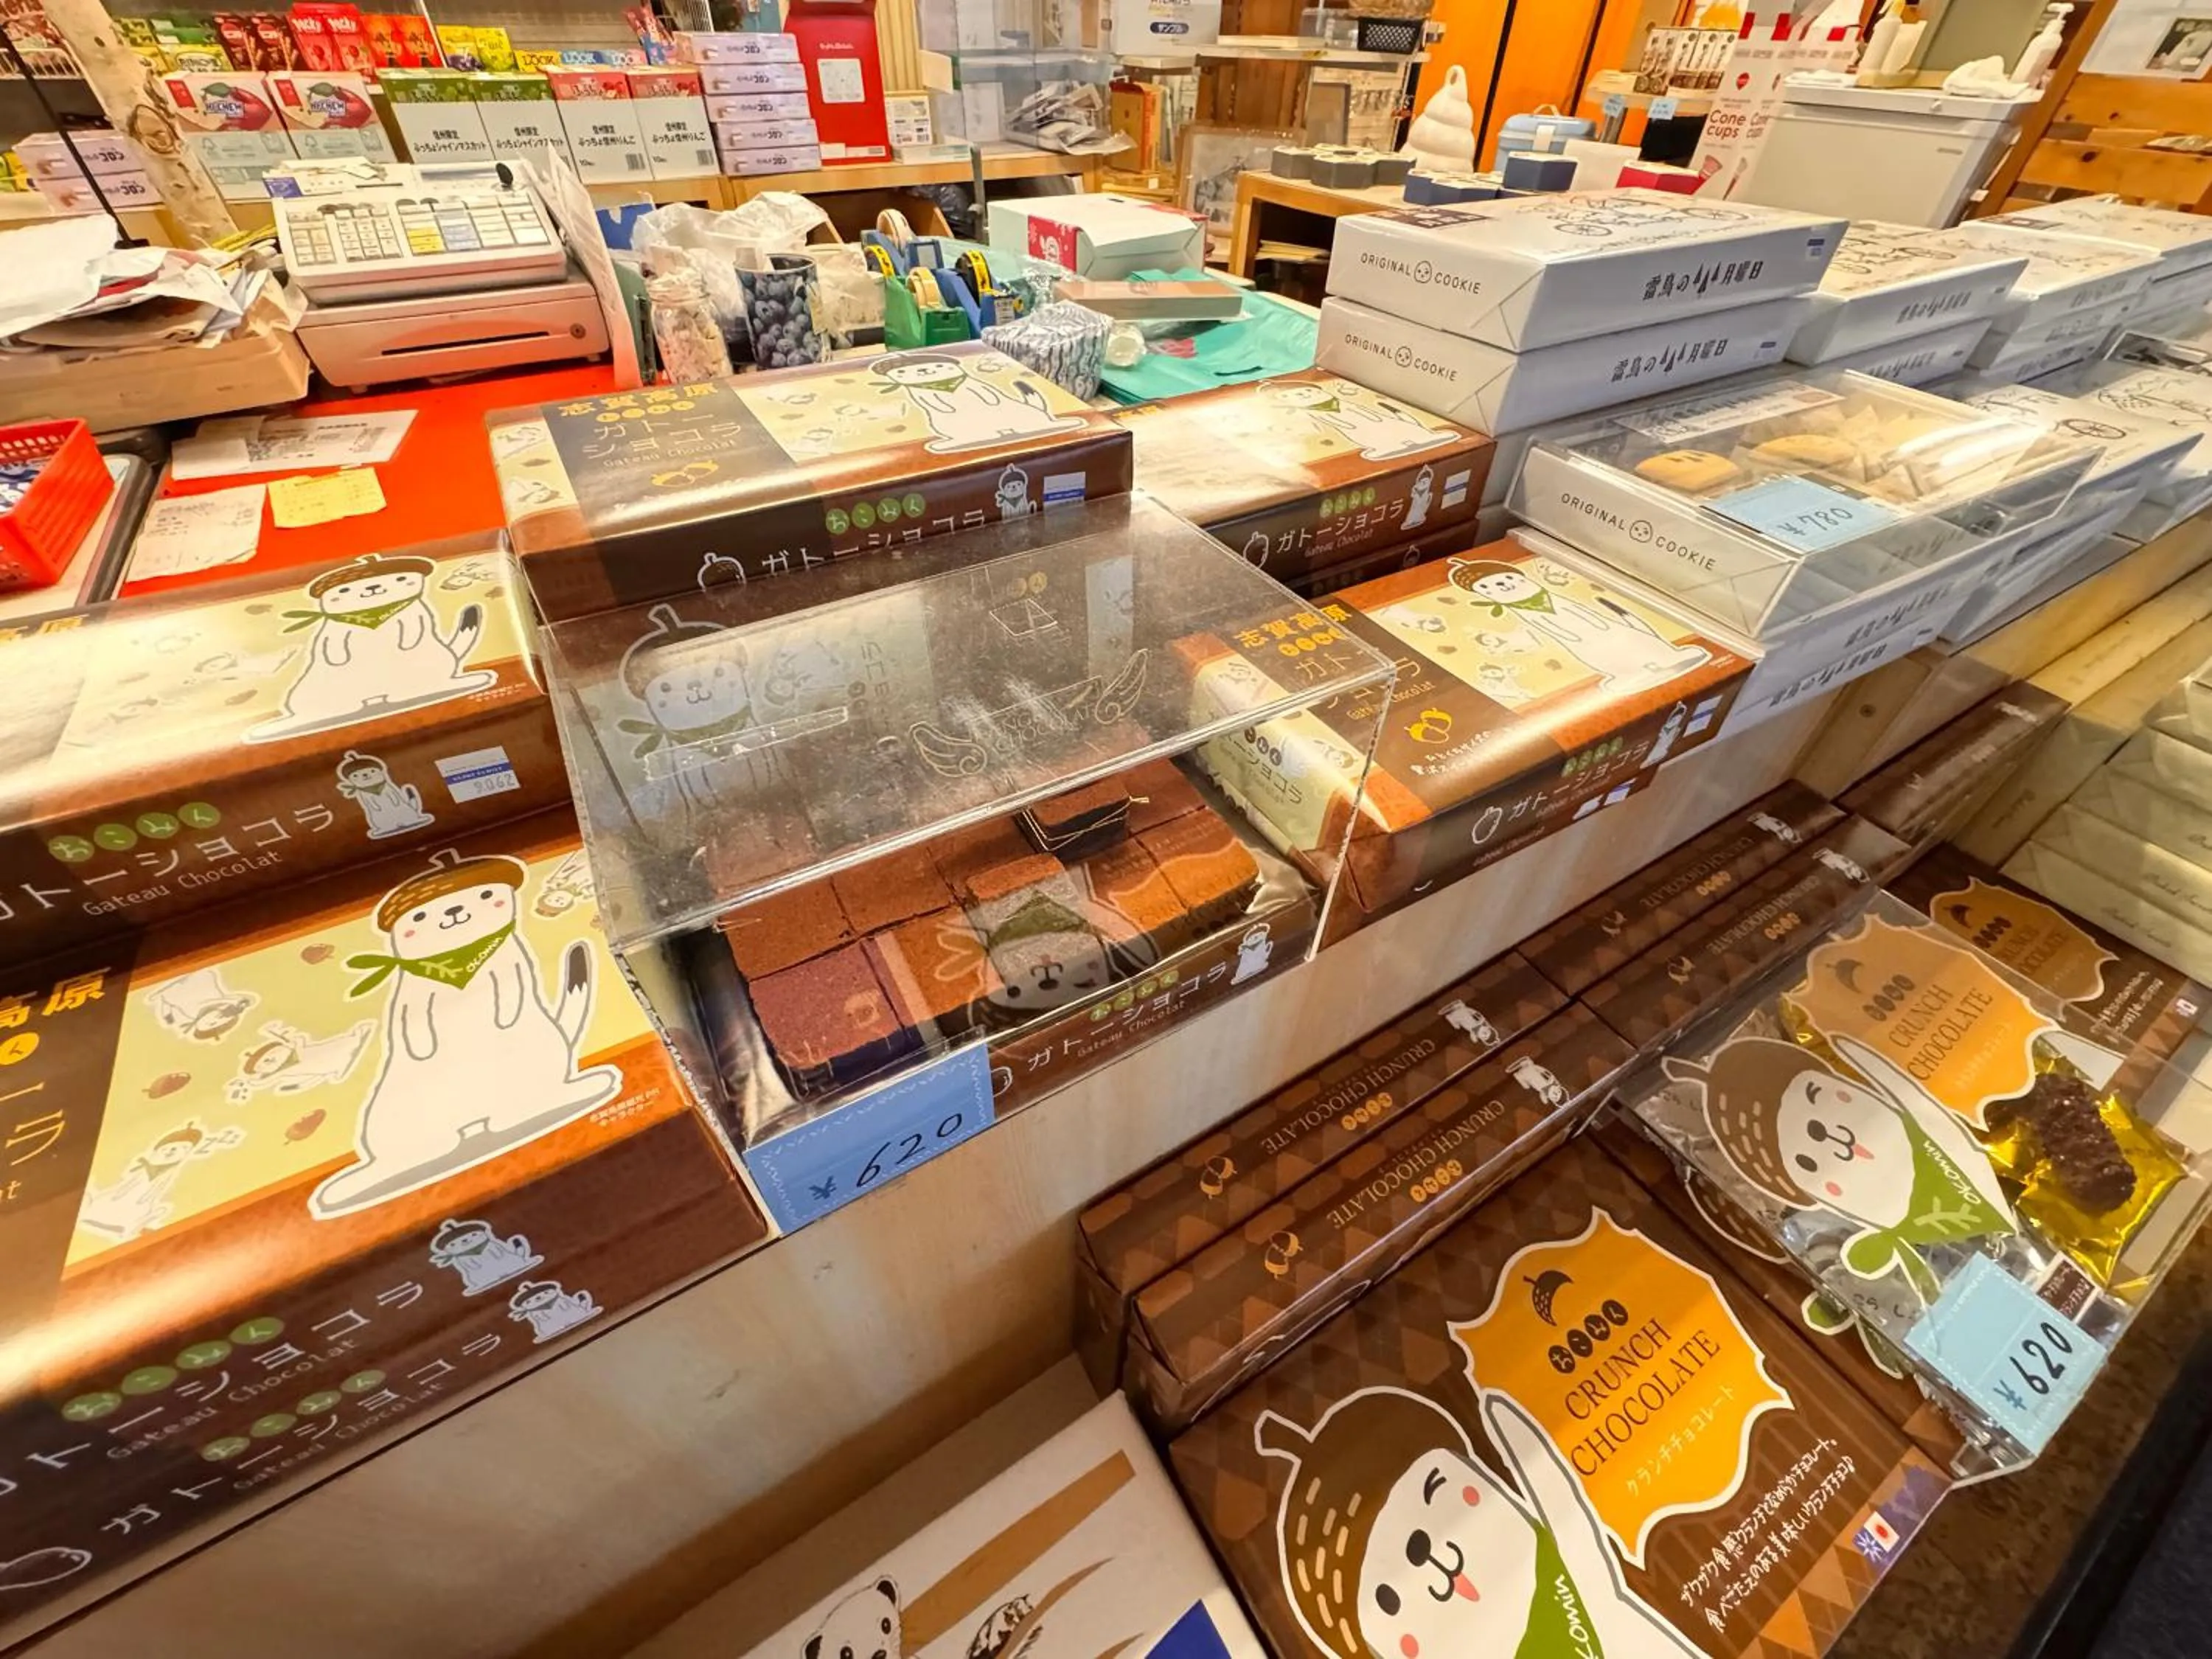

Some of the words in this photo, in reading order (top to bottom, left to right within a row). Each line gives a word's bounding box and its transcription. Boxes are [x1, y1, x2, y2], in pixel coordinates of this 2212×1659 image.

[1707, 125, 1741, 139] cups
[1710, 110, 1747, 126] Cone
[1360, 252, 1411, 278] ORIGINAL
[1434, 271, 1481, 296] COOKIE
[1344, 333, 1394, 360] ORIGINAL
[1413, 355, 1458, 382] COOKIE
[582, 422, 741, 459] ショコラ
[1276, 498, 1404, 554] ガトーショコラ
[1560, 492, 1626, 532] ORIGINAL
[1655, 535, 1718, 571] COOKIE
[1509, 740, 1650, 821] ガトーショコラ
[0, 803, 334, 921] トーショコラ
[82, 883, 171, 917] Gateau
[177, 849, 282, 888] Chocolat
[1028, 961, 1227, 1071] ガトーショコラ
[1077, 1031, 1122, 1057] Gateau
[1129, 1001, 1185, 1032] Chocolat
[1888, 984, 1954, 1048] CRUNCH
[1907, 987, 1994, 1081] CHOCOLATE
[1365, 1036, 1437, 1088] CRUNCH
[1260, 1078, 1370, 1155] CHOCOLATE
[1432, 1096, 1506, 1155] CRUNCH
[1324, 1144, 1439, 1230] CHOCOLATE
[0, 1280, 423, 1497] トーショコラ
[105, 1404, 218, 1461] Gateau
[227, 1335, 358, 1405] Chocolat
[1565, 1318, 1672, 1420] CRUNCH
[1571, 1329, 1721, 1476] CHOCOLATE
[1993, 1321, 2073, 1411] ¥620
[100, 1333, 502, 1536] ガトーショコラ
[232, 1440, 327, 1491] Gateau
[334, 1378, 447, 1442] Chocolat
[1627, 1385, 1734, 1498] クランチチョコレート
